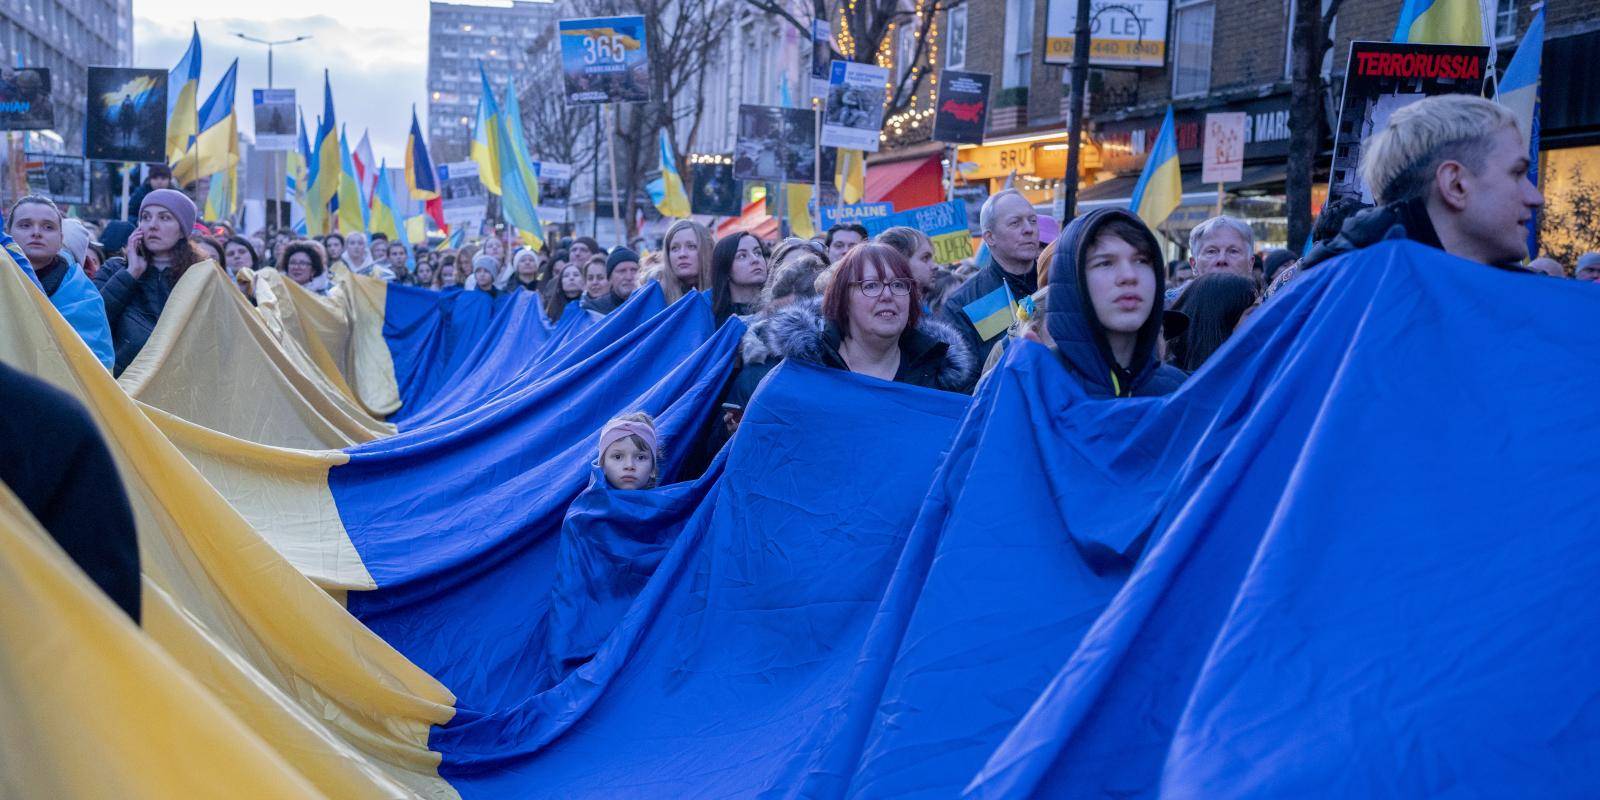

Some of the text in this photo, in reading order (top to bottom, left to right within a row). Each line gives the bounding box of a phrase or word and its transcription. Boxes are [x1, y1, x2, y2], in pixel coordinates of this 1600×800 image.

[1110, 17, 1153, 35] LET
[583, 34, 625, 64] 365
[1094, 43, 1120, 54] 440
[1357, 52, 1480, 79] TERRORUSSIA
[827, 205, 887, 220] UKRAINE
